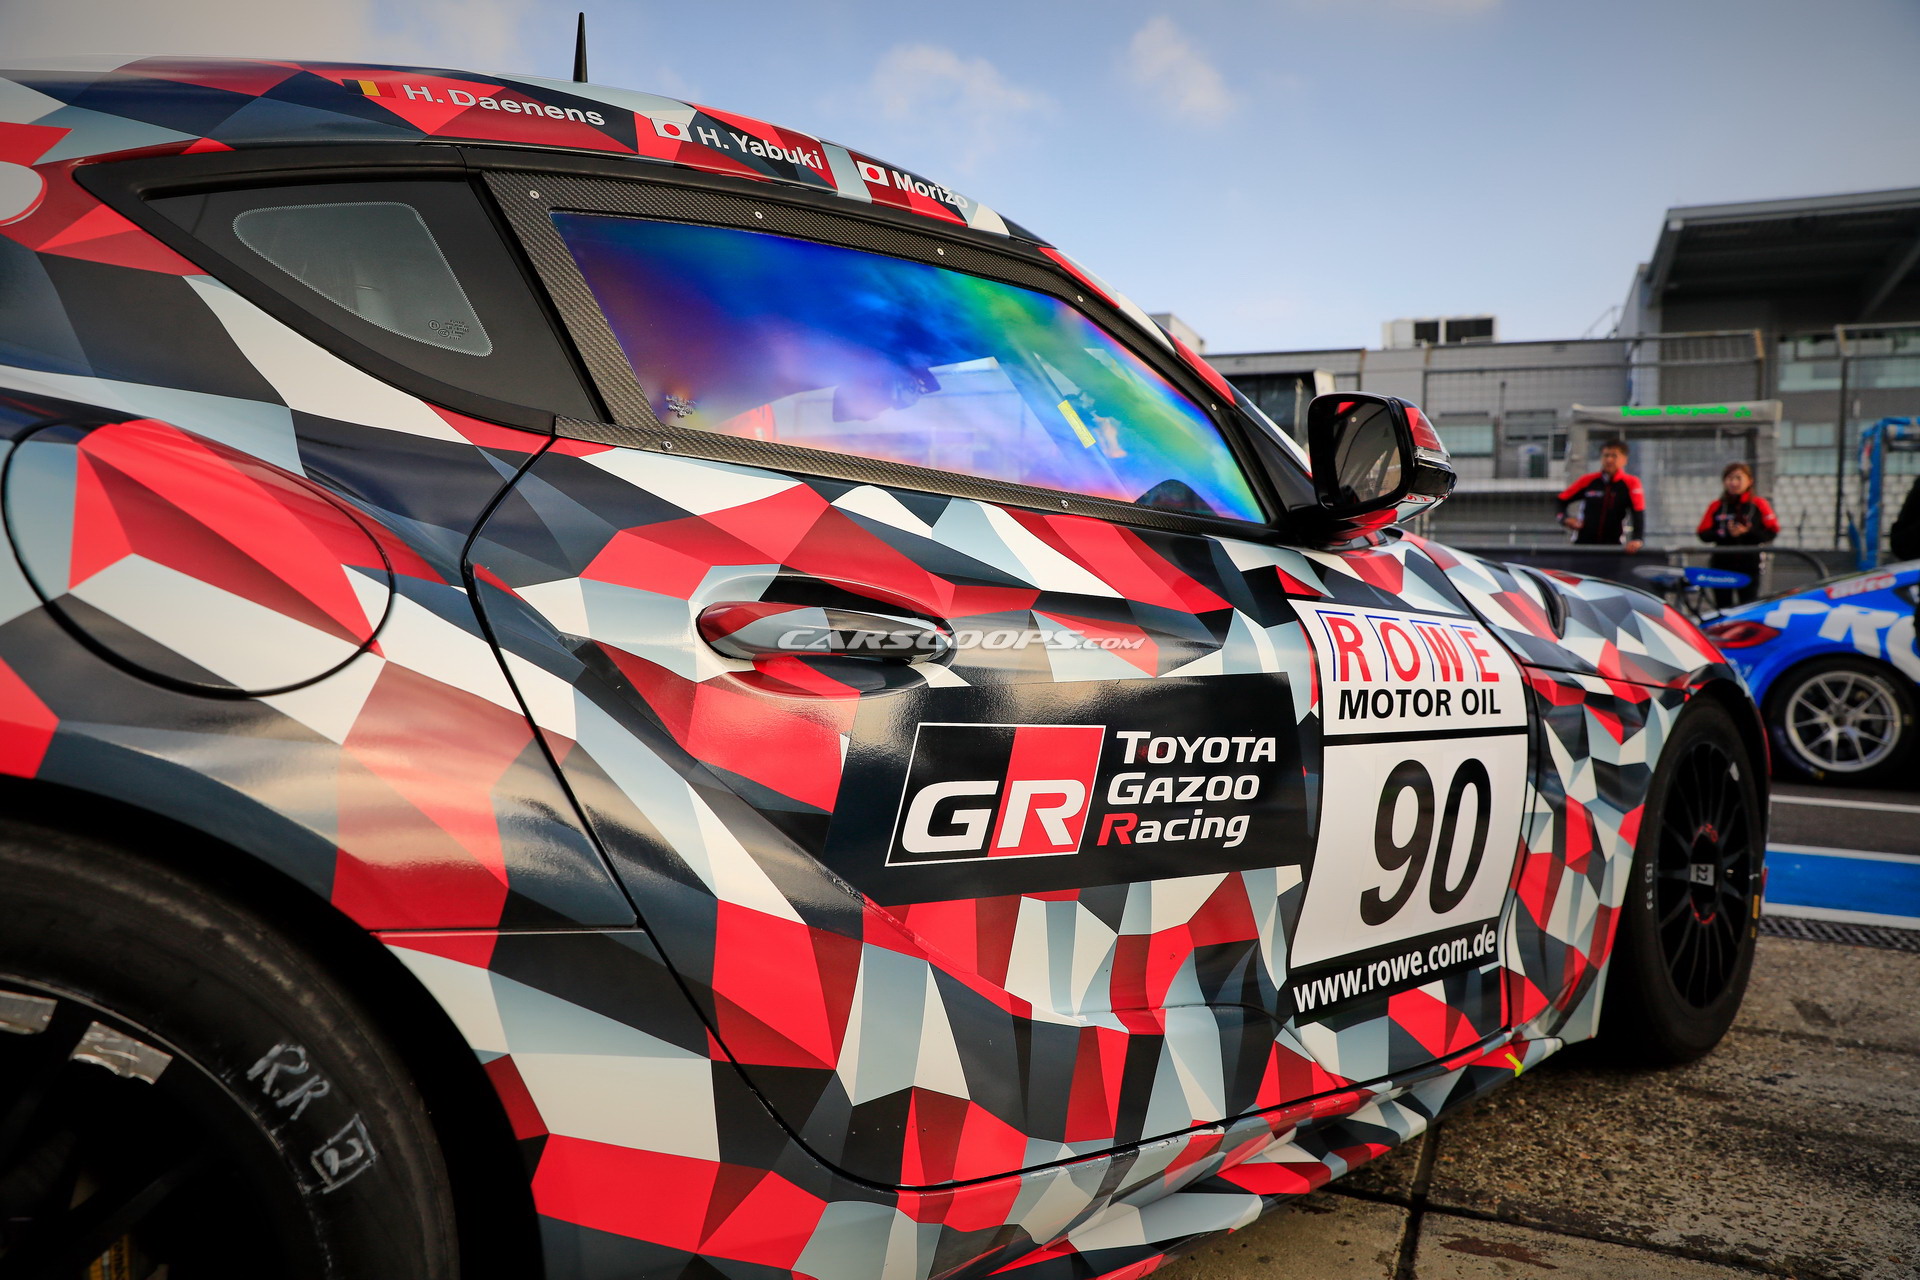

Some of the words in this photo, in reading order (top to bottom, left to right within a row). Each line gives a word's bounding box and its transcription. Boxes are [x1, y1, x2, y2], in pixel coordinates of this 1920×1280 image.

[404, 82, 446, 105] H.
[449, 88, 606, 127] Daenens
[696, 125, 731, 151] H.
[730, 130, 823, 171] Yabuki
[889, 169, 969, 210] Morizo
[1326, 613, 1500, 683] ROWE
[1338, 688, 1451, 721] MOTOR
[1461, 687, 1502, 716] OIL
[900, 779, 1086, 854] GR
[1096, 807, 1251, 849] Racing
[1359, 757, 1493, 927] 90
[1696, 865, 1707, 882] 22
[1293, 923, 1498, 1013] www.rowe.com.de
[247, 1042, 332, 1121] RR
